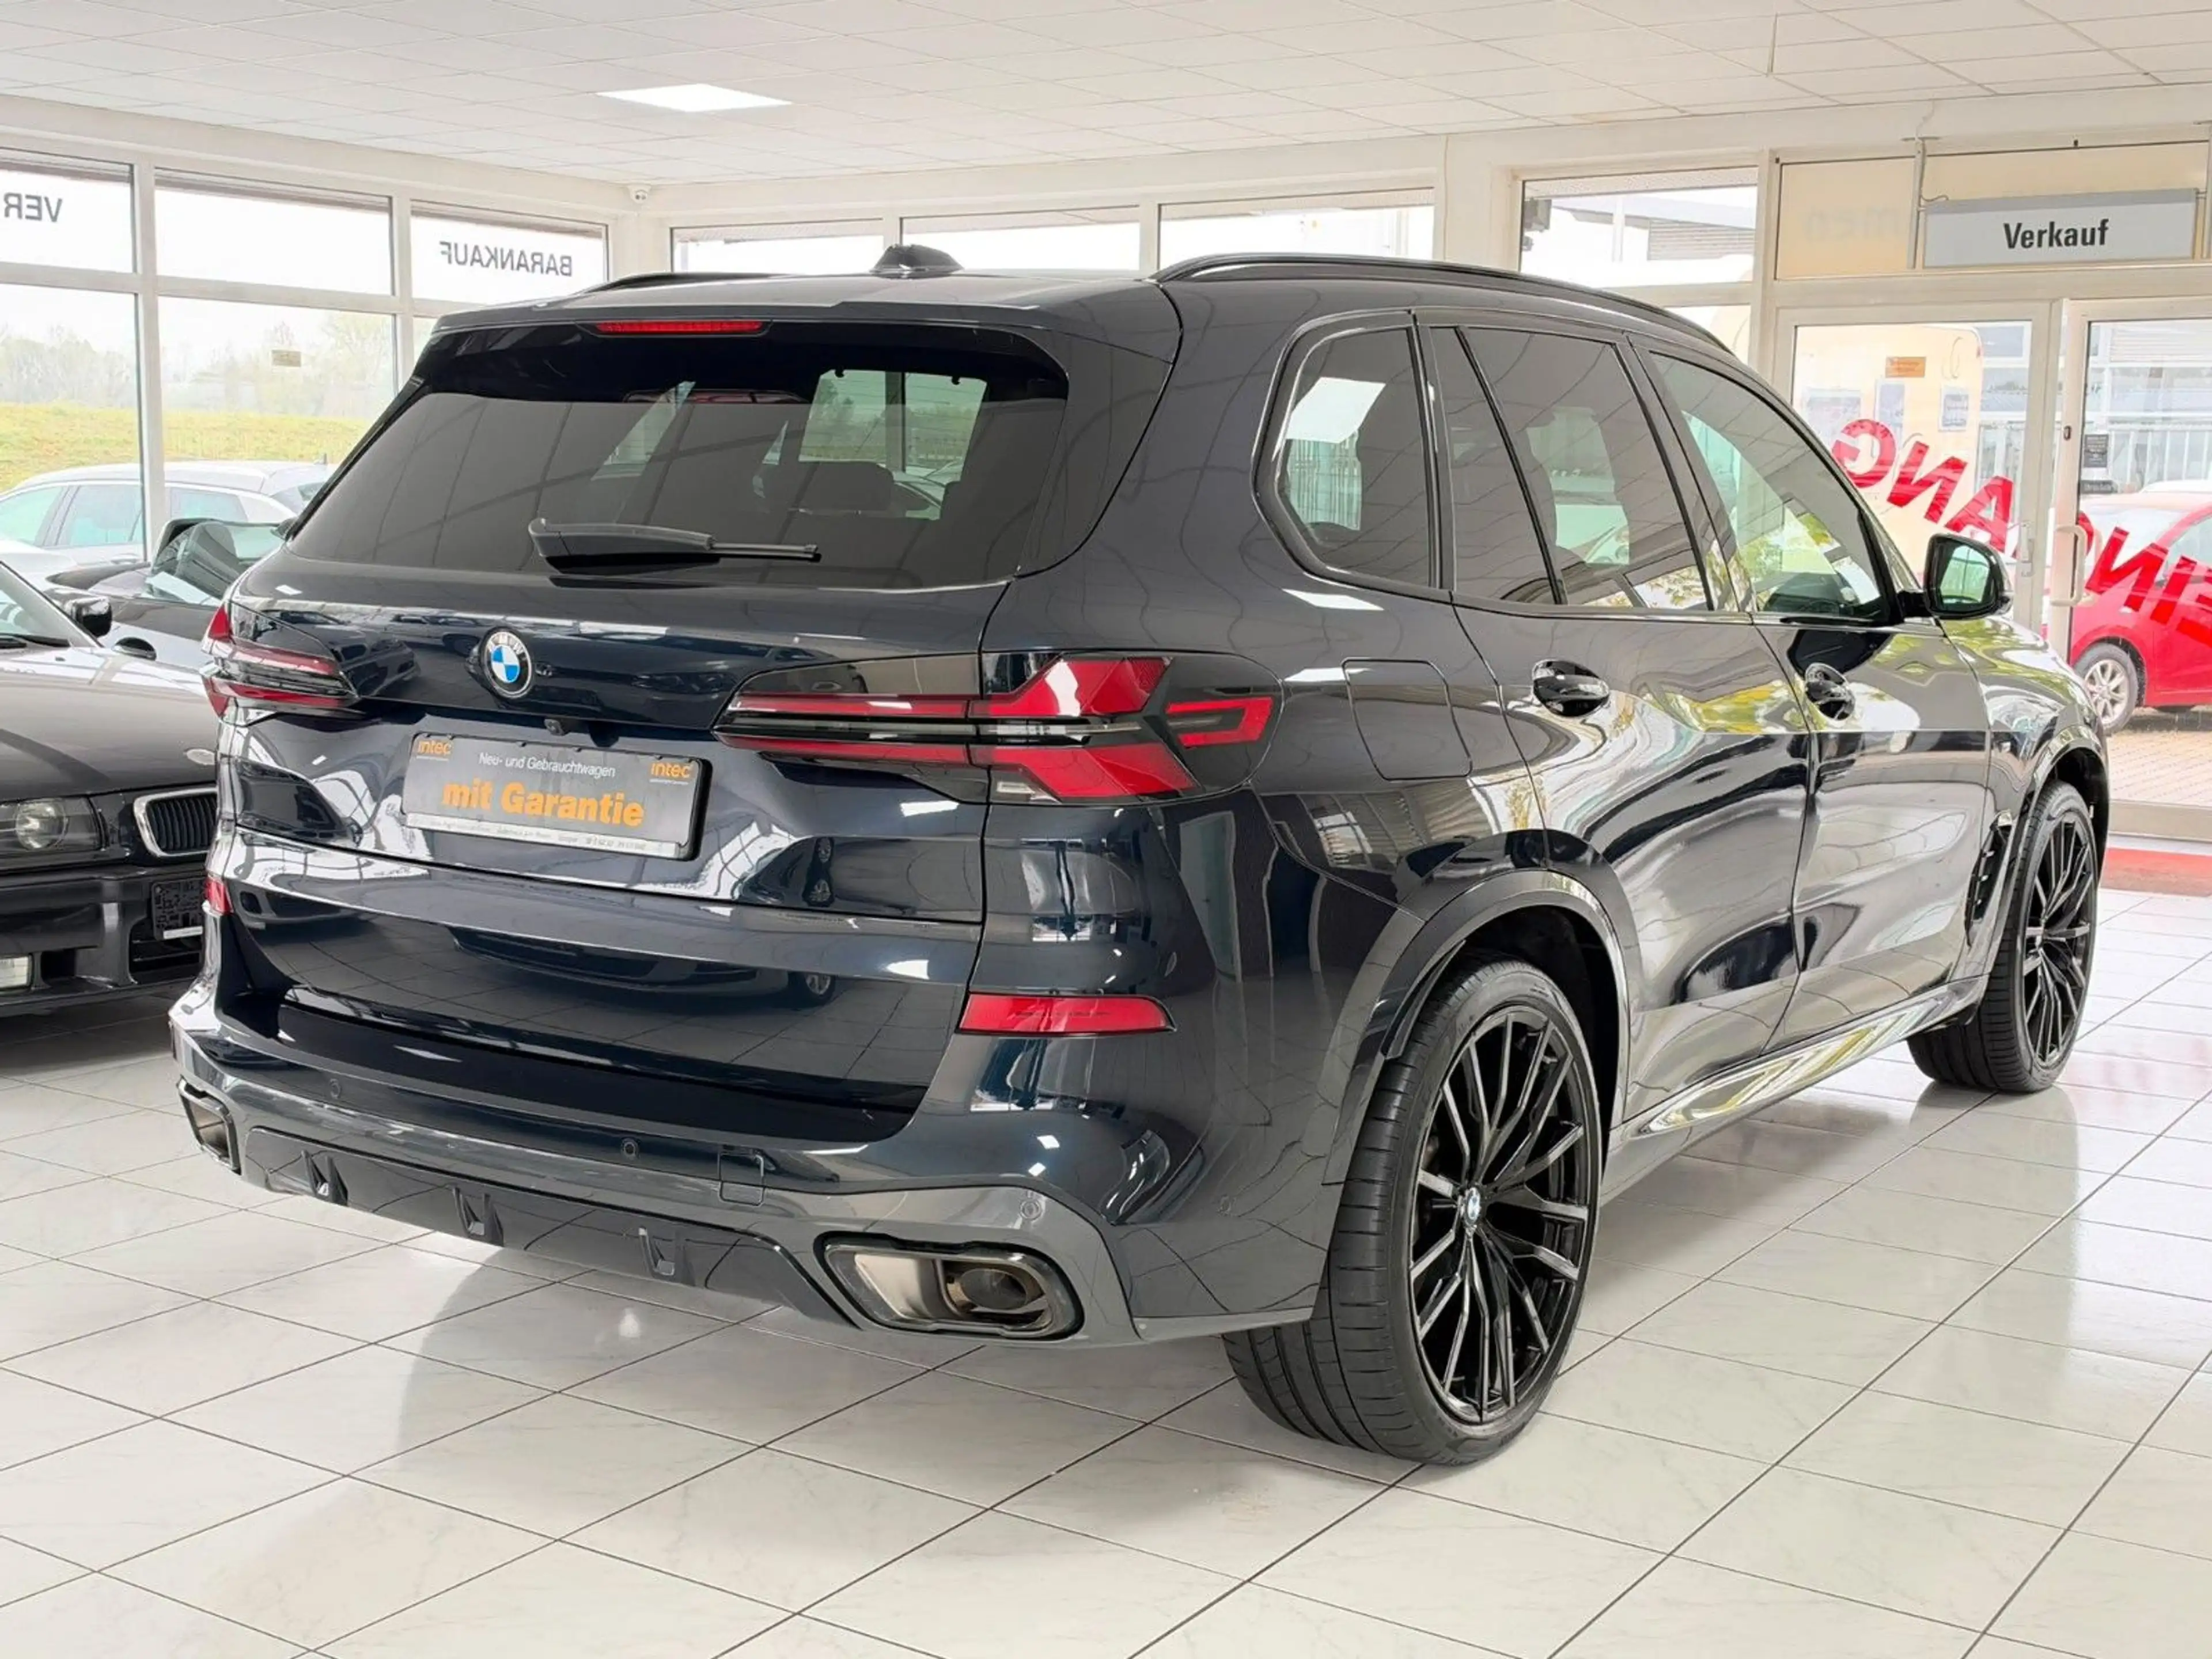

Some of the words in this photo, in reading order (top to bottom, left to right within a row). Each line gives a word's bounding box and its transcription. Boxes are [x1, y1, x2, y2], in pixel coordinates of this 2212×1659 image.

[2003, 218, 2109, 249] Verkauf
[479, 752, 503, 766] Neu-
[505, 755, 525, 768] und
[527, 756, 616, 779] Gebrauchtwagen
[651, 762, 692, 778] intec
[442, 778, 493, 810] mit
[501, 781, 645, 827] Garantie
